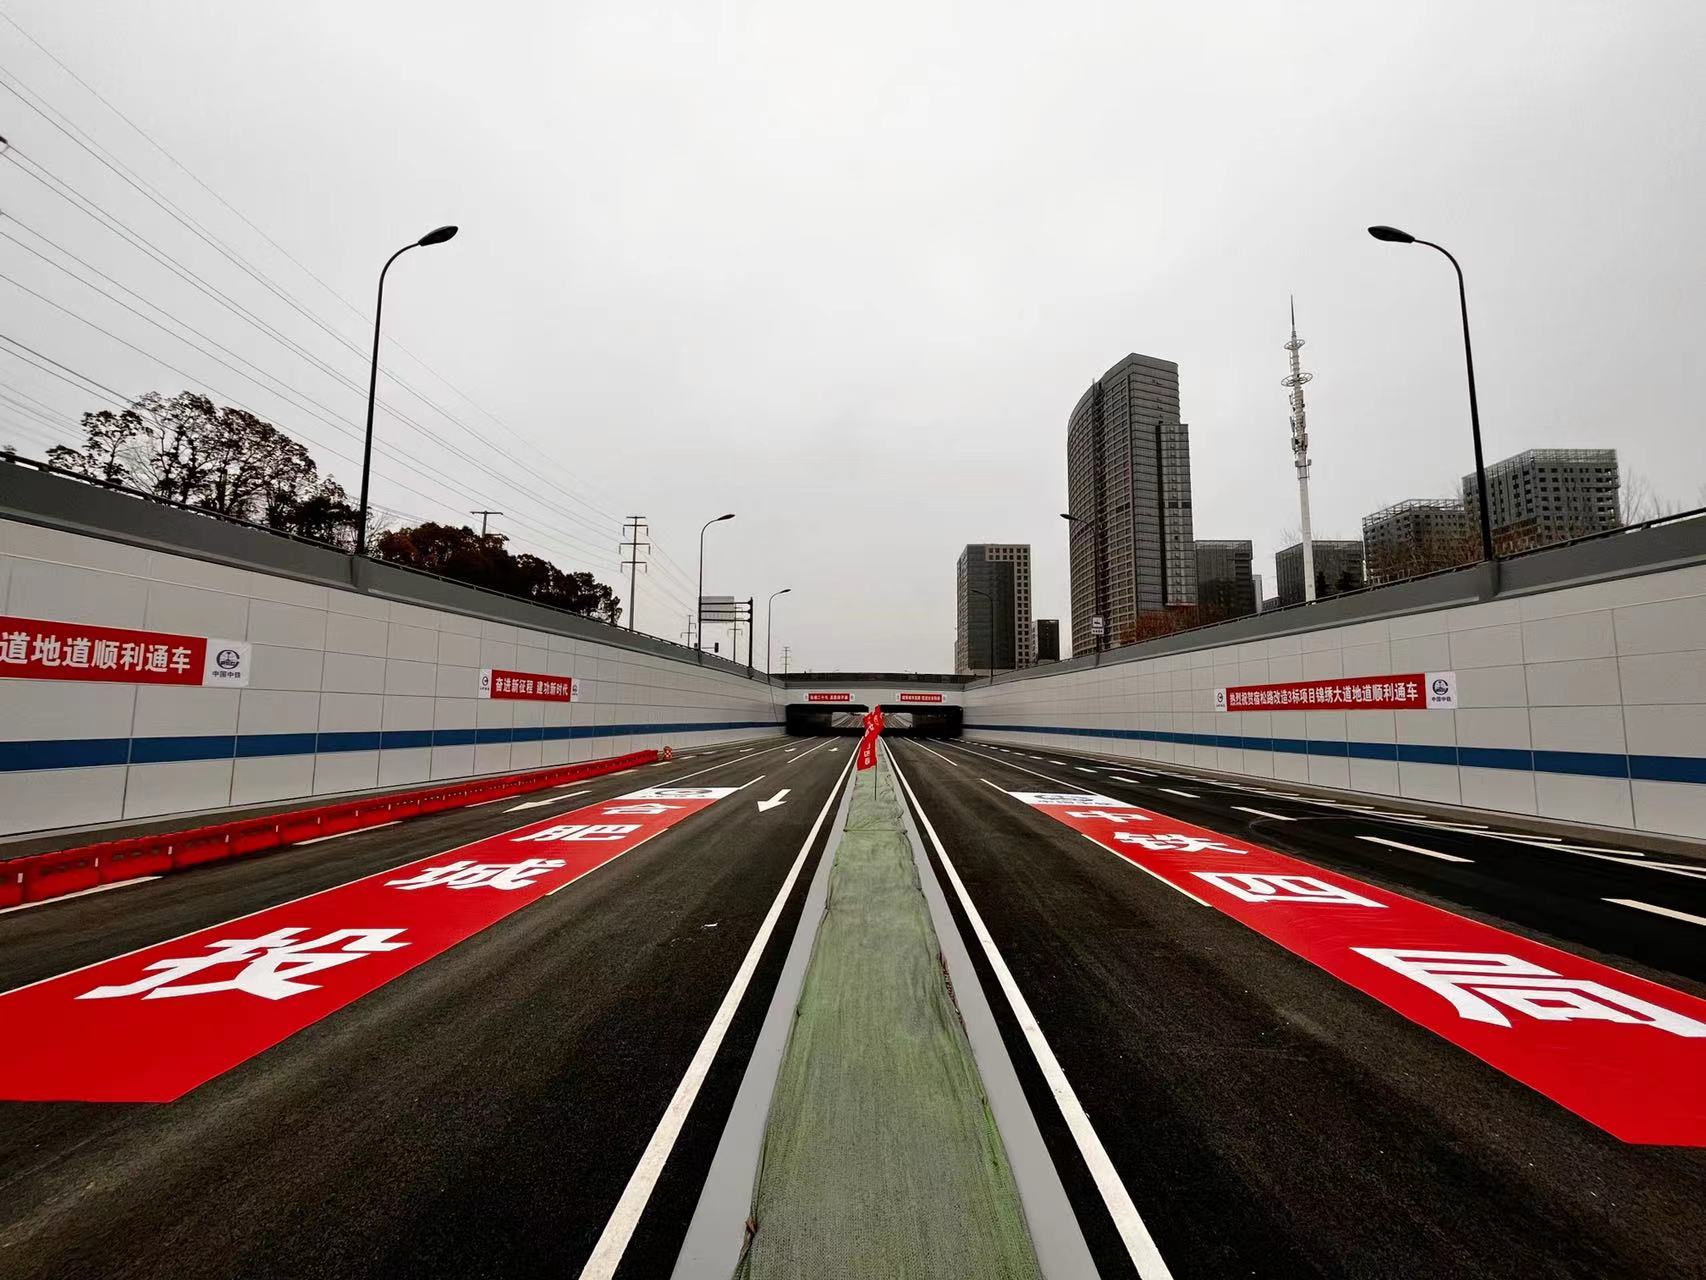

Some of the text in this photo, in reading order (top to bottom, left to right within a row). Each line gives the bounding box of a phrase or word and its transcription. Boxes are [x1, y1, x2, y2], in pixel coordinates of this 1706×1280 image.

[0, 631, 193, 674] 道地道顺利通车
[212, 670, 241, 679] 中国中铁
[495, 677, 569, 696] 奋进新征程 建功新时代
